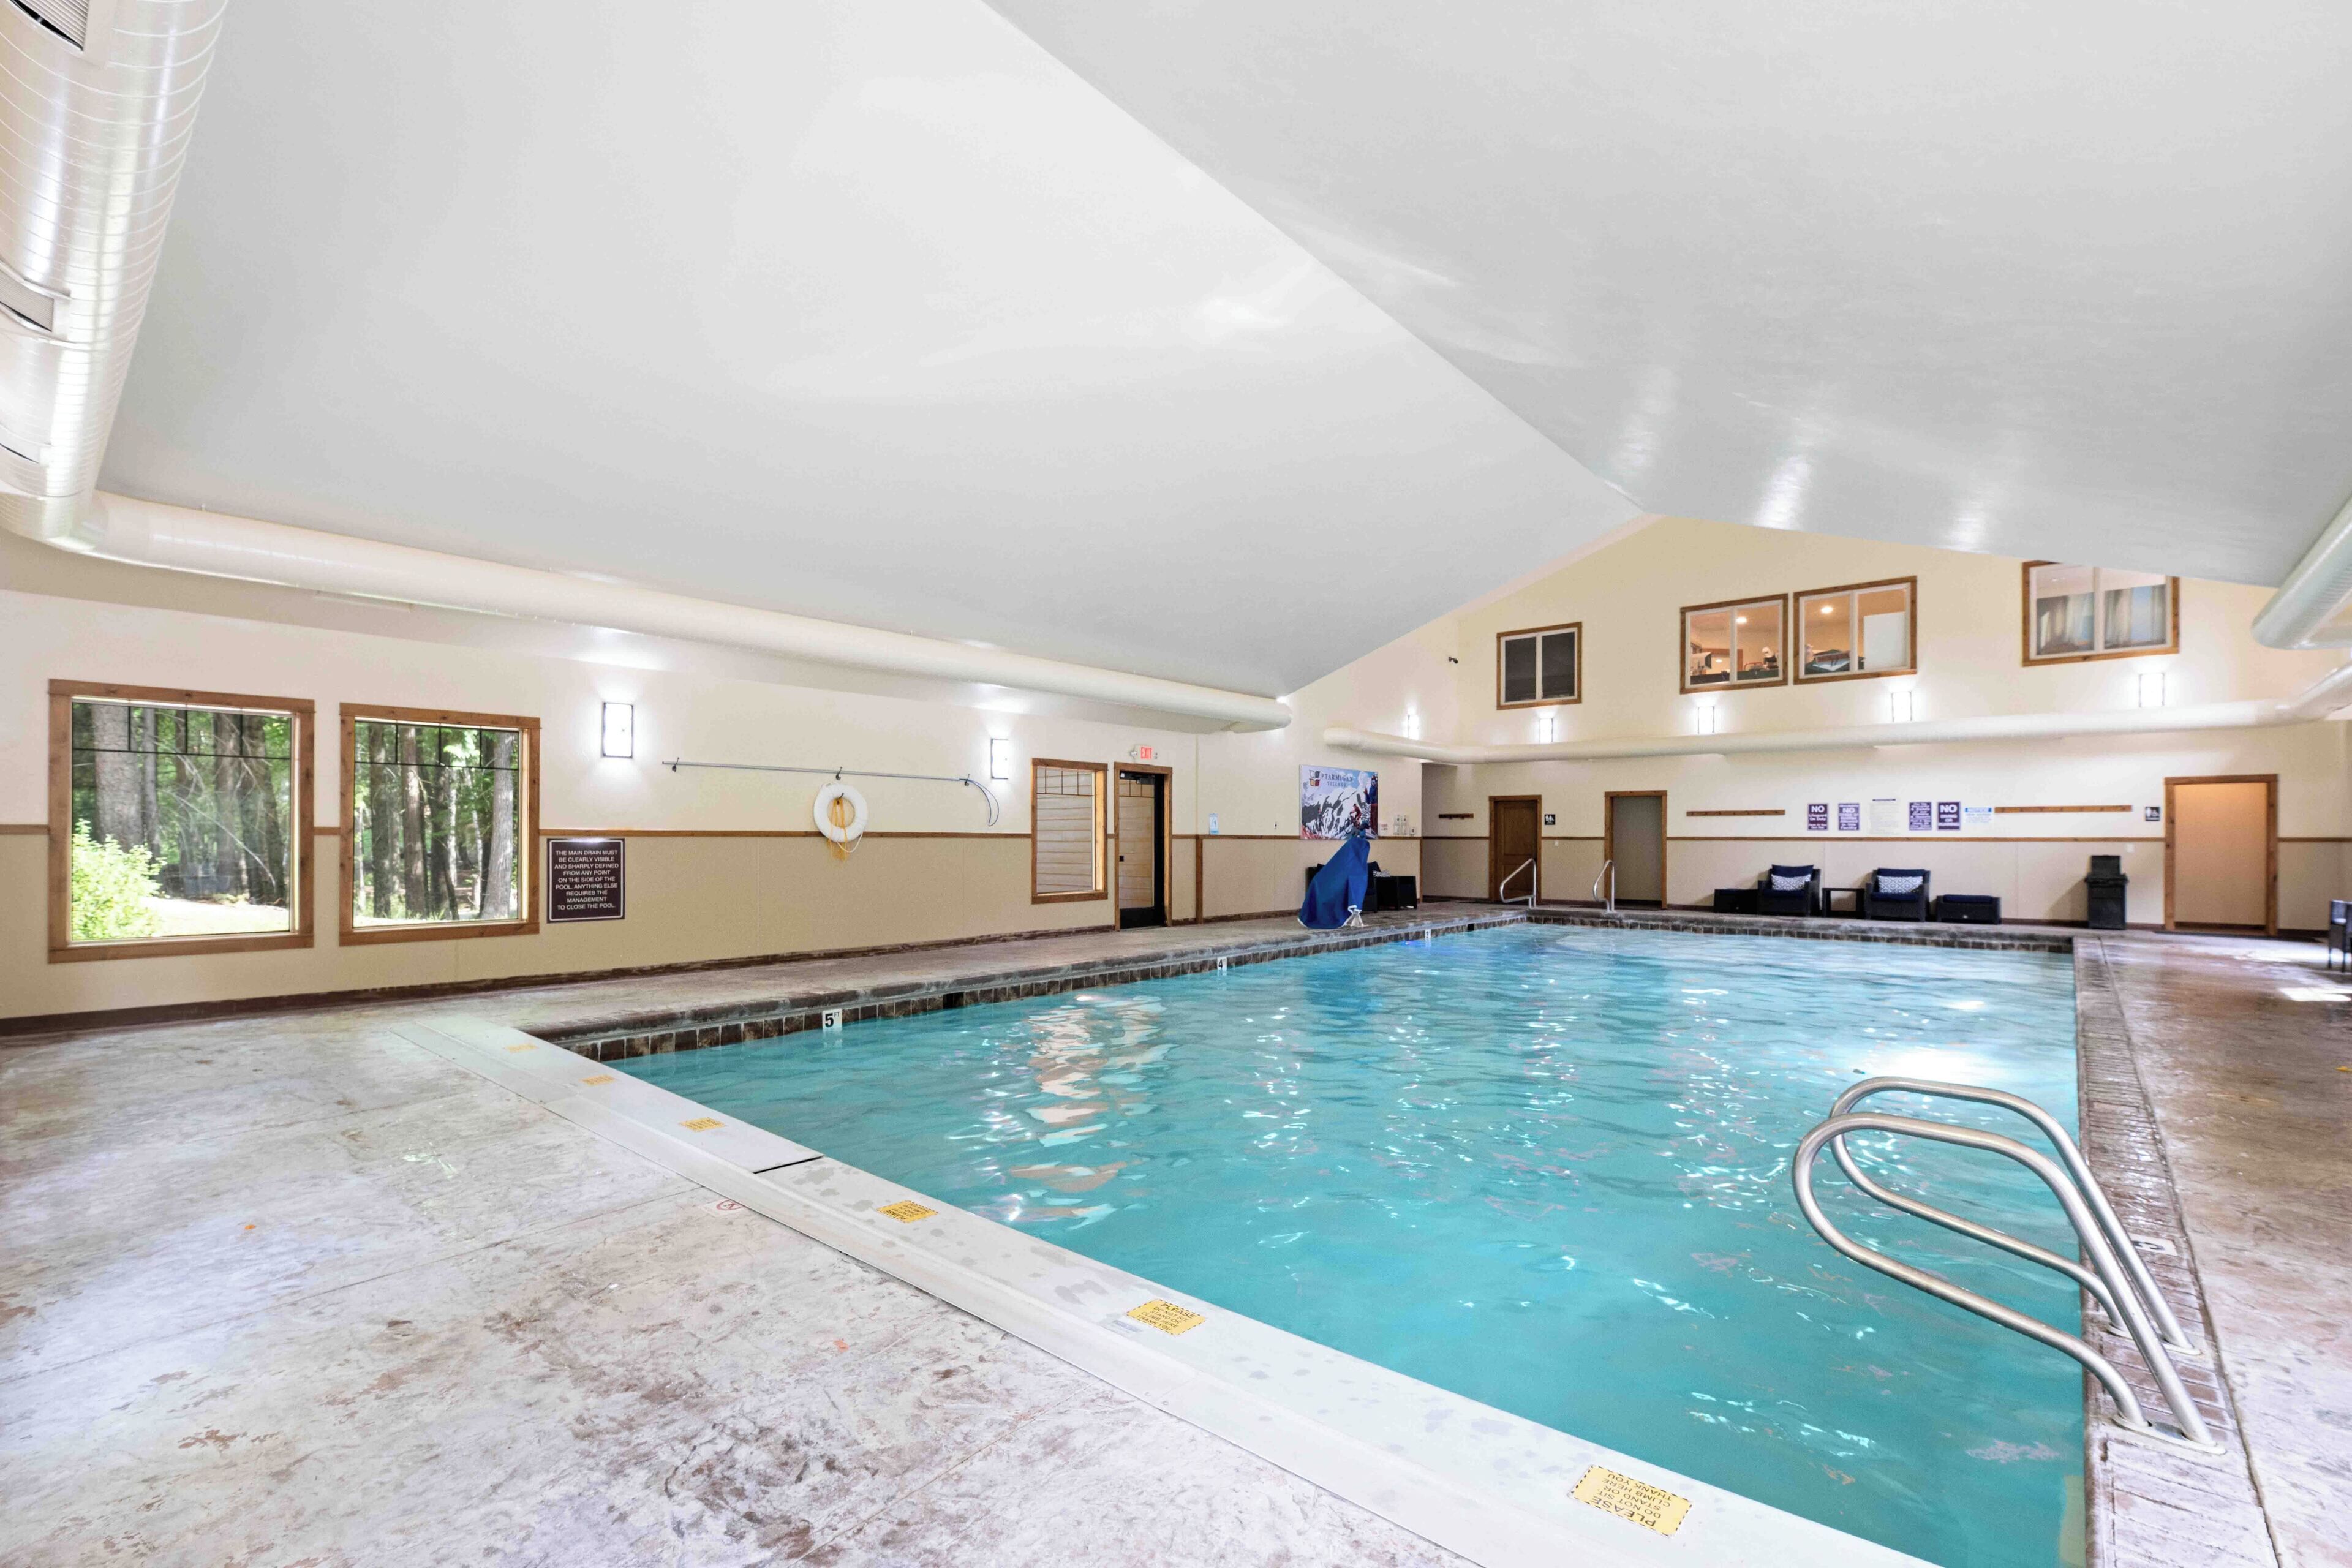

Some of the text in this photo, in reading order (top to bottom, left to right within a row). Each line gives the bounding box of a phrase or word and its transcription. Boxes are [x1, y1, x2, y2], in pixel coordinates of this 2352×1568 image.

[1141, 747, 1152, 759] EXIT
[1219, 959, 1223, 969] 4
[825, 1013, 834, 1027] 5
[1150, 1310, 1171, 1319] STAND
[1161, 1303, 1196, 1319] PLEASE
[1137, 1315, 1156, 1325] THANK
[1141, 1312, 1179, 1328] CLIMB HERE
[1602, 1478, 1671, 1507] CLIMB HERE
[1607, 1474, 1672, 1501] THANK YOU
[1604, 1486, 1661, 1510] STAND OR
[1618, 1499, 1642, 1510] NOT
[1591, 1496, 1657, 1527] PLEASE
[1645, 1508, 1662, 1519] DO
